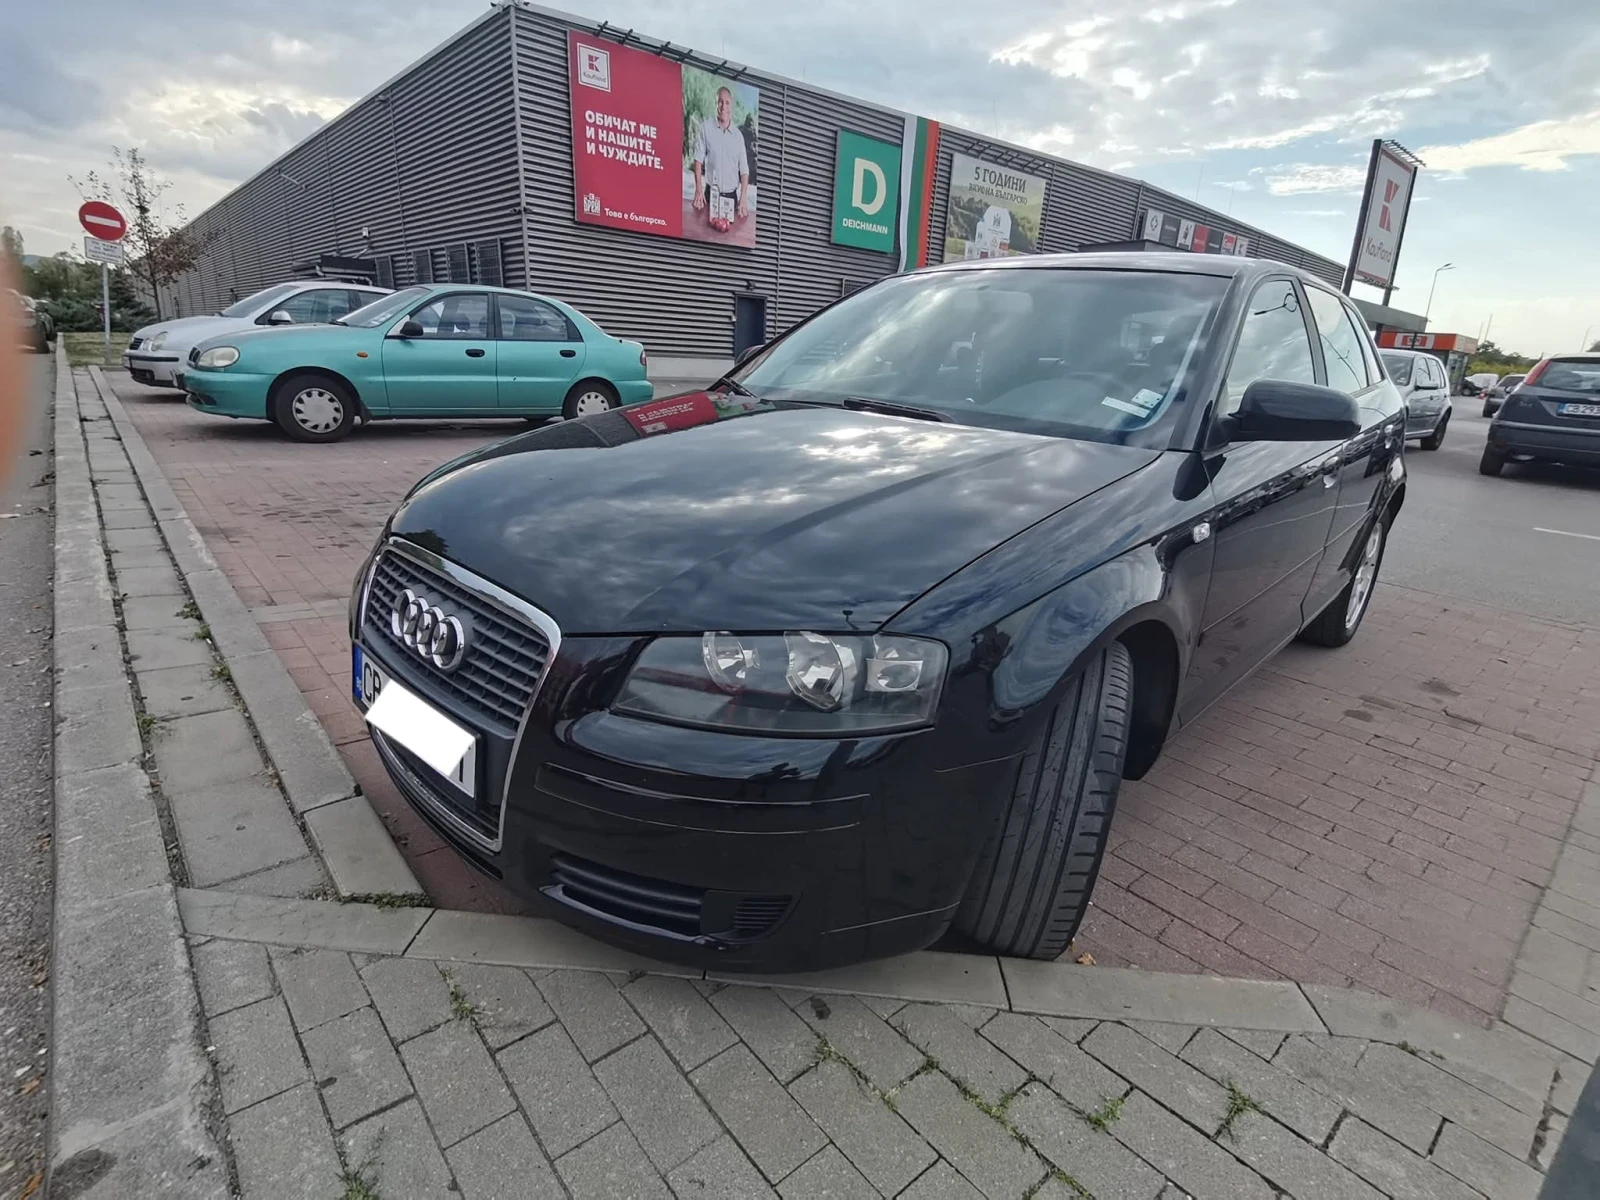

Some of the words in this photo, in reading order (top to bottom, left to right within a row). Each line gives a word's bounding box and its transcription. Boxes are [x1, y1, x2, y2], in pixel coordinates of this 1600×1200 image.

[585, 110, 637, 134] ОБИЧАТ
[639, 123, 657, 140] МЕ
[586, 125, 595, 140] И
[598, 128, 655, 155] НАШИТЕ,
[586, 141, 596, 155] И
[598, 143, 664, 170] ЧУЖДИТЕ.
[851, 157, 886, 215] D
[974, 166, 981, 181] 5
[982, 168, 1027, 194] ГОДИНИ
[604, 207, 623, 219] Това
[623, 212, 629, 220] е
[629, 211, 668, 226] българско.
[842, 217, 888, 235] DEICHMANN
